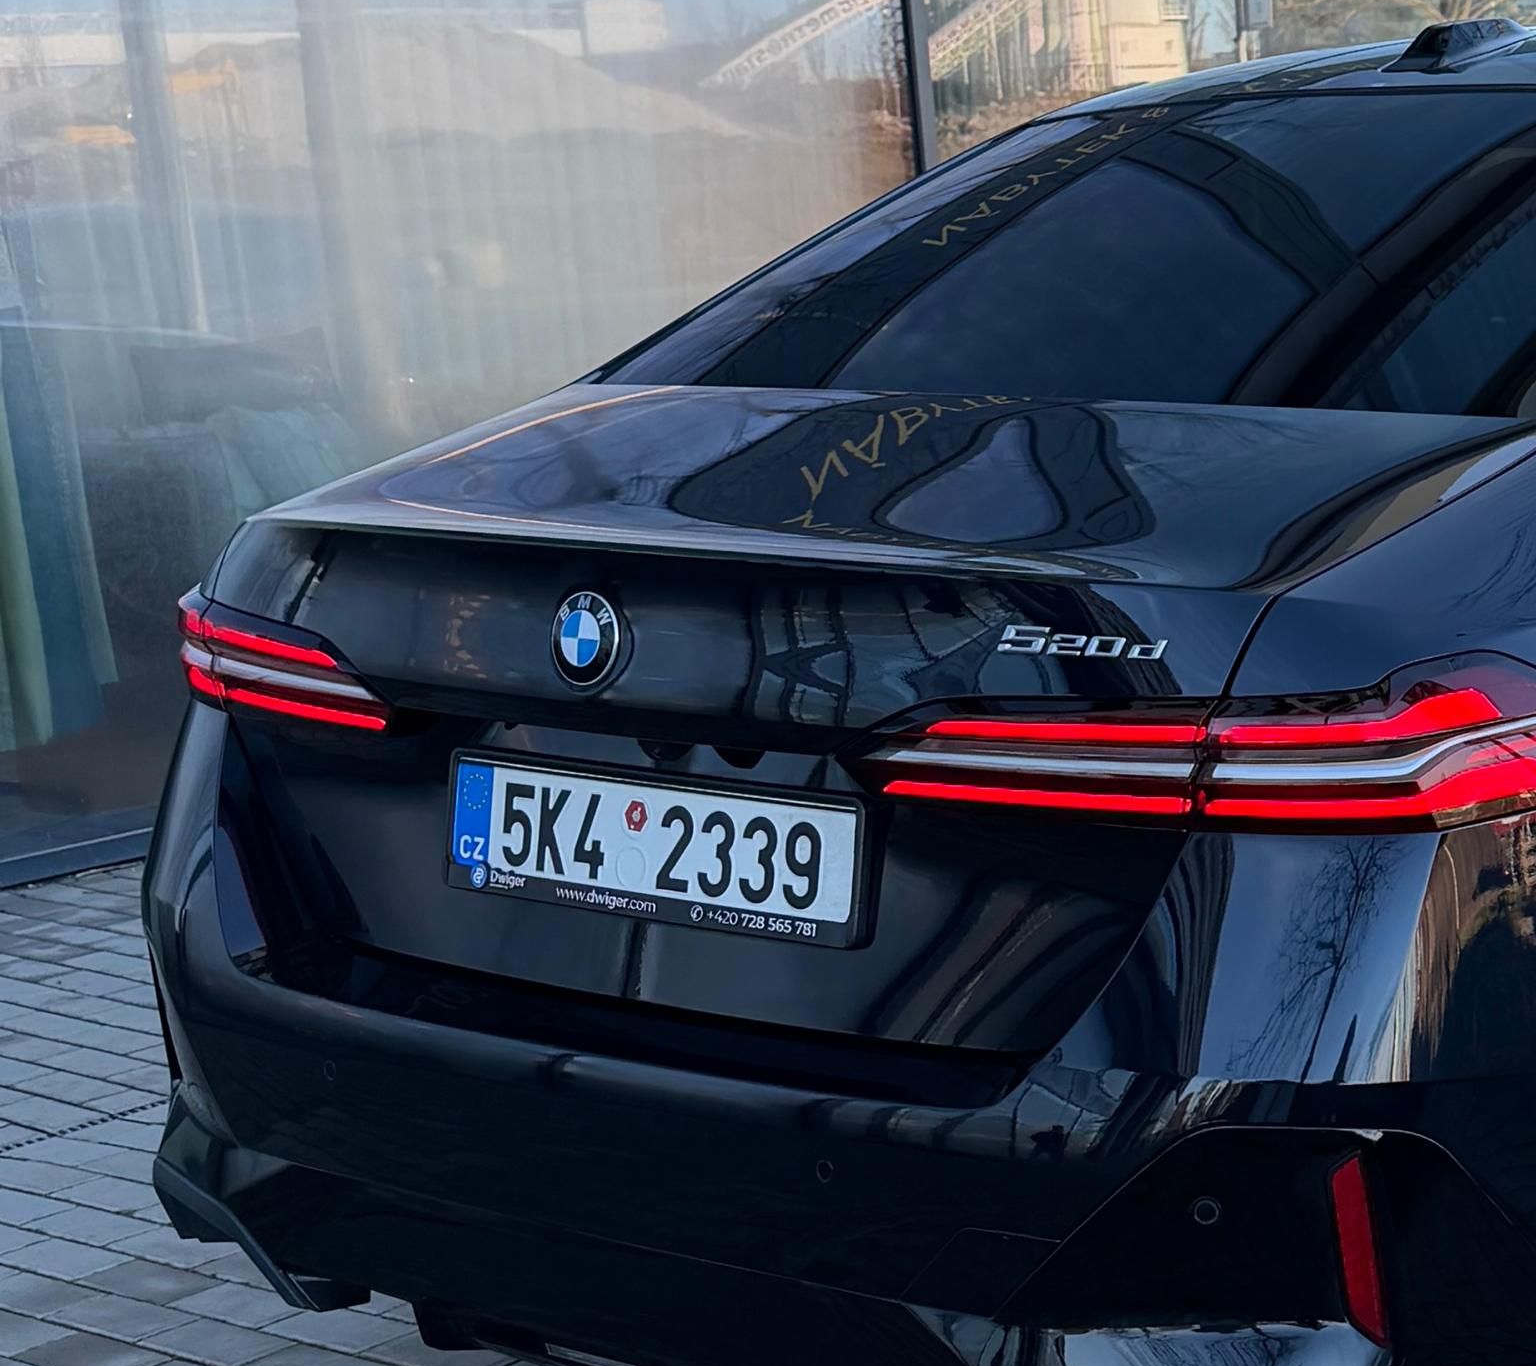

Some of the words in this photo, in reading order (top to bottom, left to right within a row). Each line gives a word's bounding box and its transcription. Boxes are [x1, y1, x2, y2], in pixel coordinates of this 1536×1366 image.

[559, 595, 612, 626] BMW
[459, 834, 486, 861] CZ
[502, 782, 605, 880] 5K4
[655, 805, 822, 910] 2339
[489, 869, 527, 889] Dwiger
[555, 886, 657, 913] www.dwiger.com
[706, 910, 738, 926] +420
[740, 913, 765, 929] 728
[767, 917, 792, 934] 565
[795, 921, 817, 937] 781
